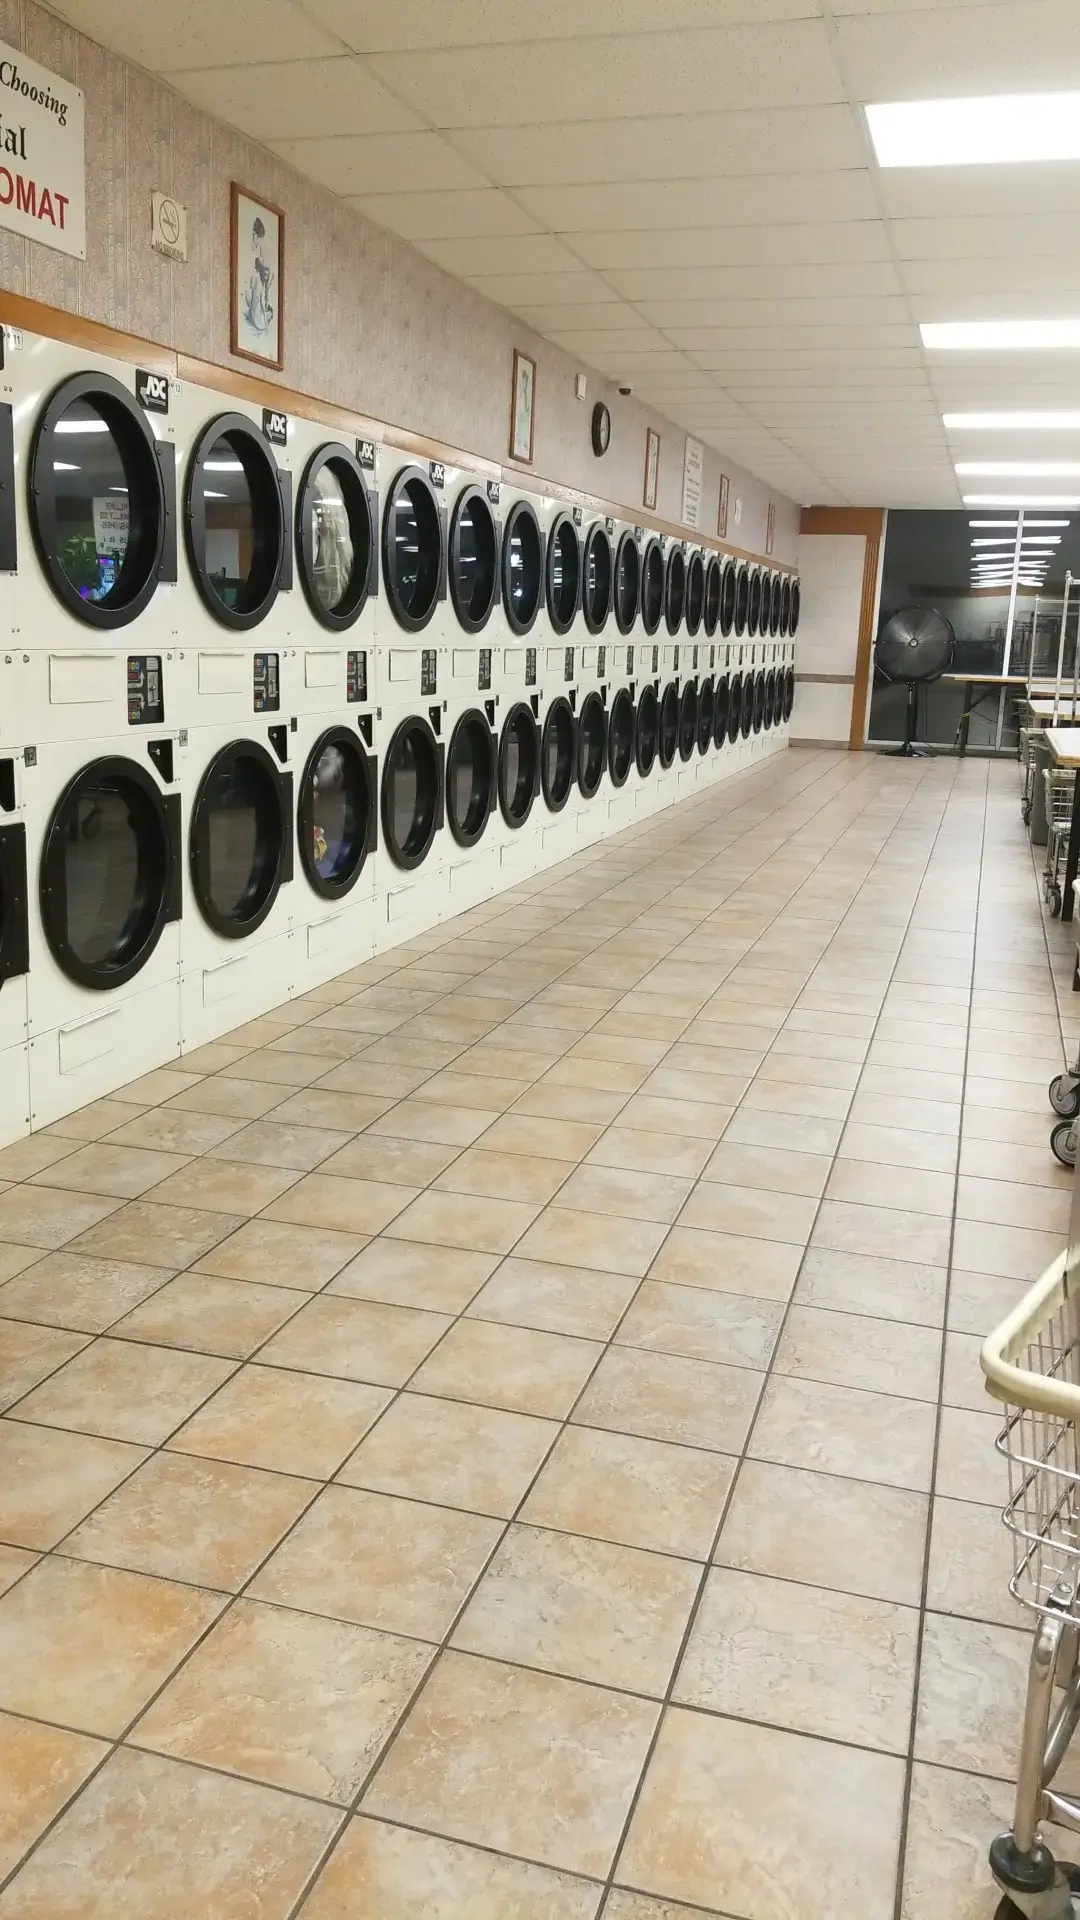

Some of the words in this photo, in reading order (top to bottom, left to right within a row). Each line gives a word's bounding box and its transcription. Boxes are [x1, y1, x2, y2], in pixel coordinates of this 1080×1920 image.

[0, 61, 69, 126] Choosing
[0, 166, 69, 230] OMAT
[146, 375, 166, 400] ADC
[270, 413, 286, 434] ADC
